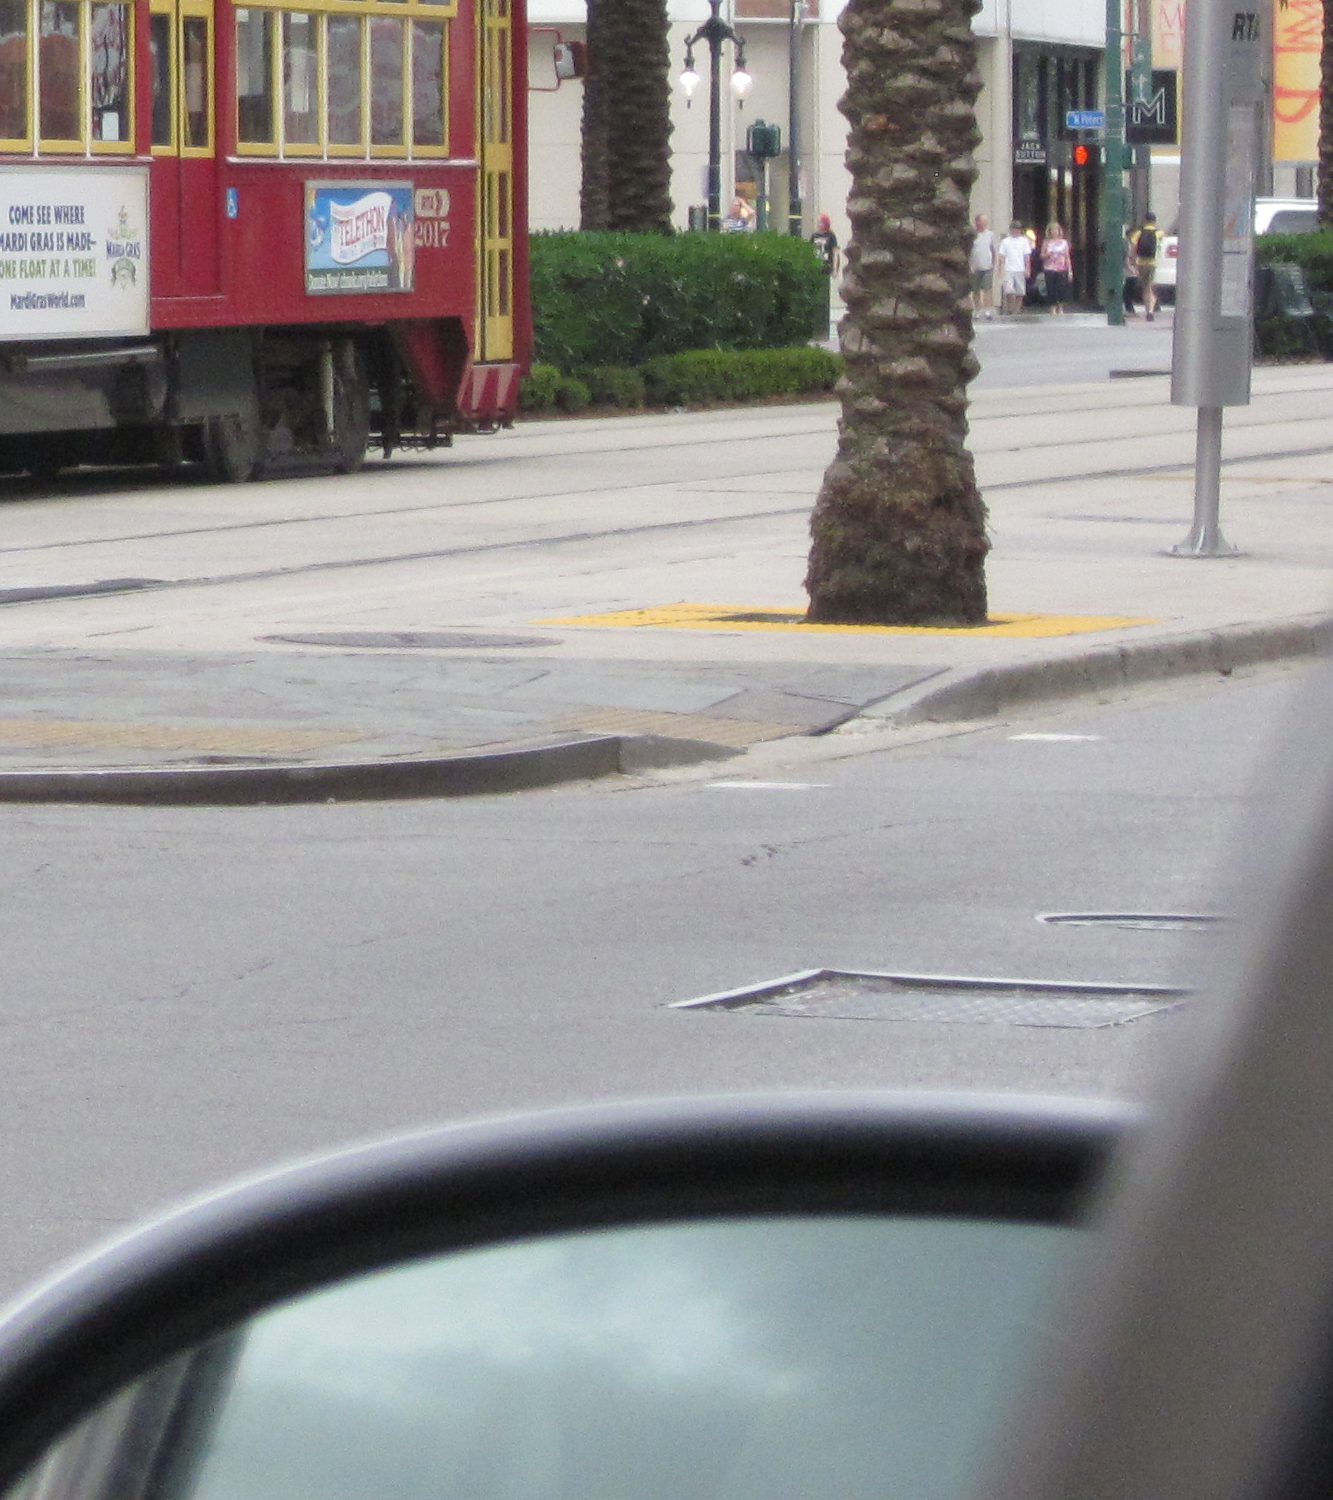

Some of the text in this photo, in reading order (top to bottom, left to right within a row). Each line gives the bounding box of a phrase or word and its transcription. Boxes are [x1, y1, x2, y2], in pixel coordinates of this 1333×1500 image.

[8, 205, 85, 225] COME SEE WHERE
[338, 206, 385, 247] TELETHON
[414, 221, 450, 248] 2017
[30, 232, 54, 251] GRAS
[57, 232, 65, 251] IS
[19, 259, 47, 279] FLOAT
[49, 259, 60, 278] AT
[63, 259, 70, 277] A
[72, 258, 96, 277] TIME!
[10, 290, 85, 310] MardiGrasWorld.com
